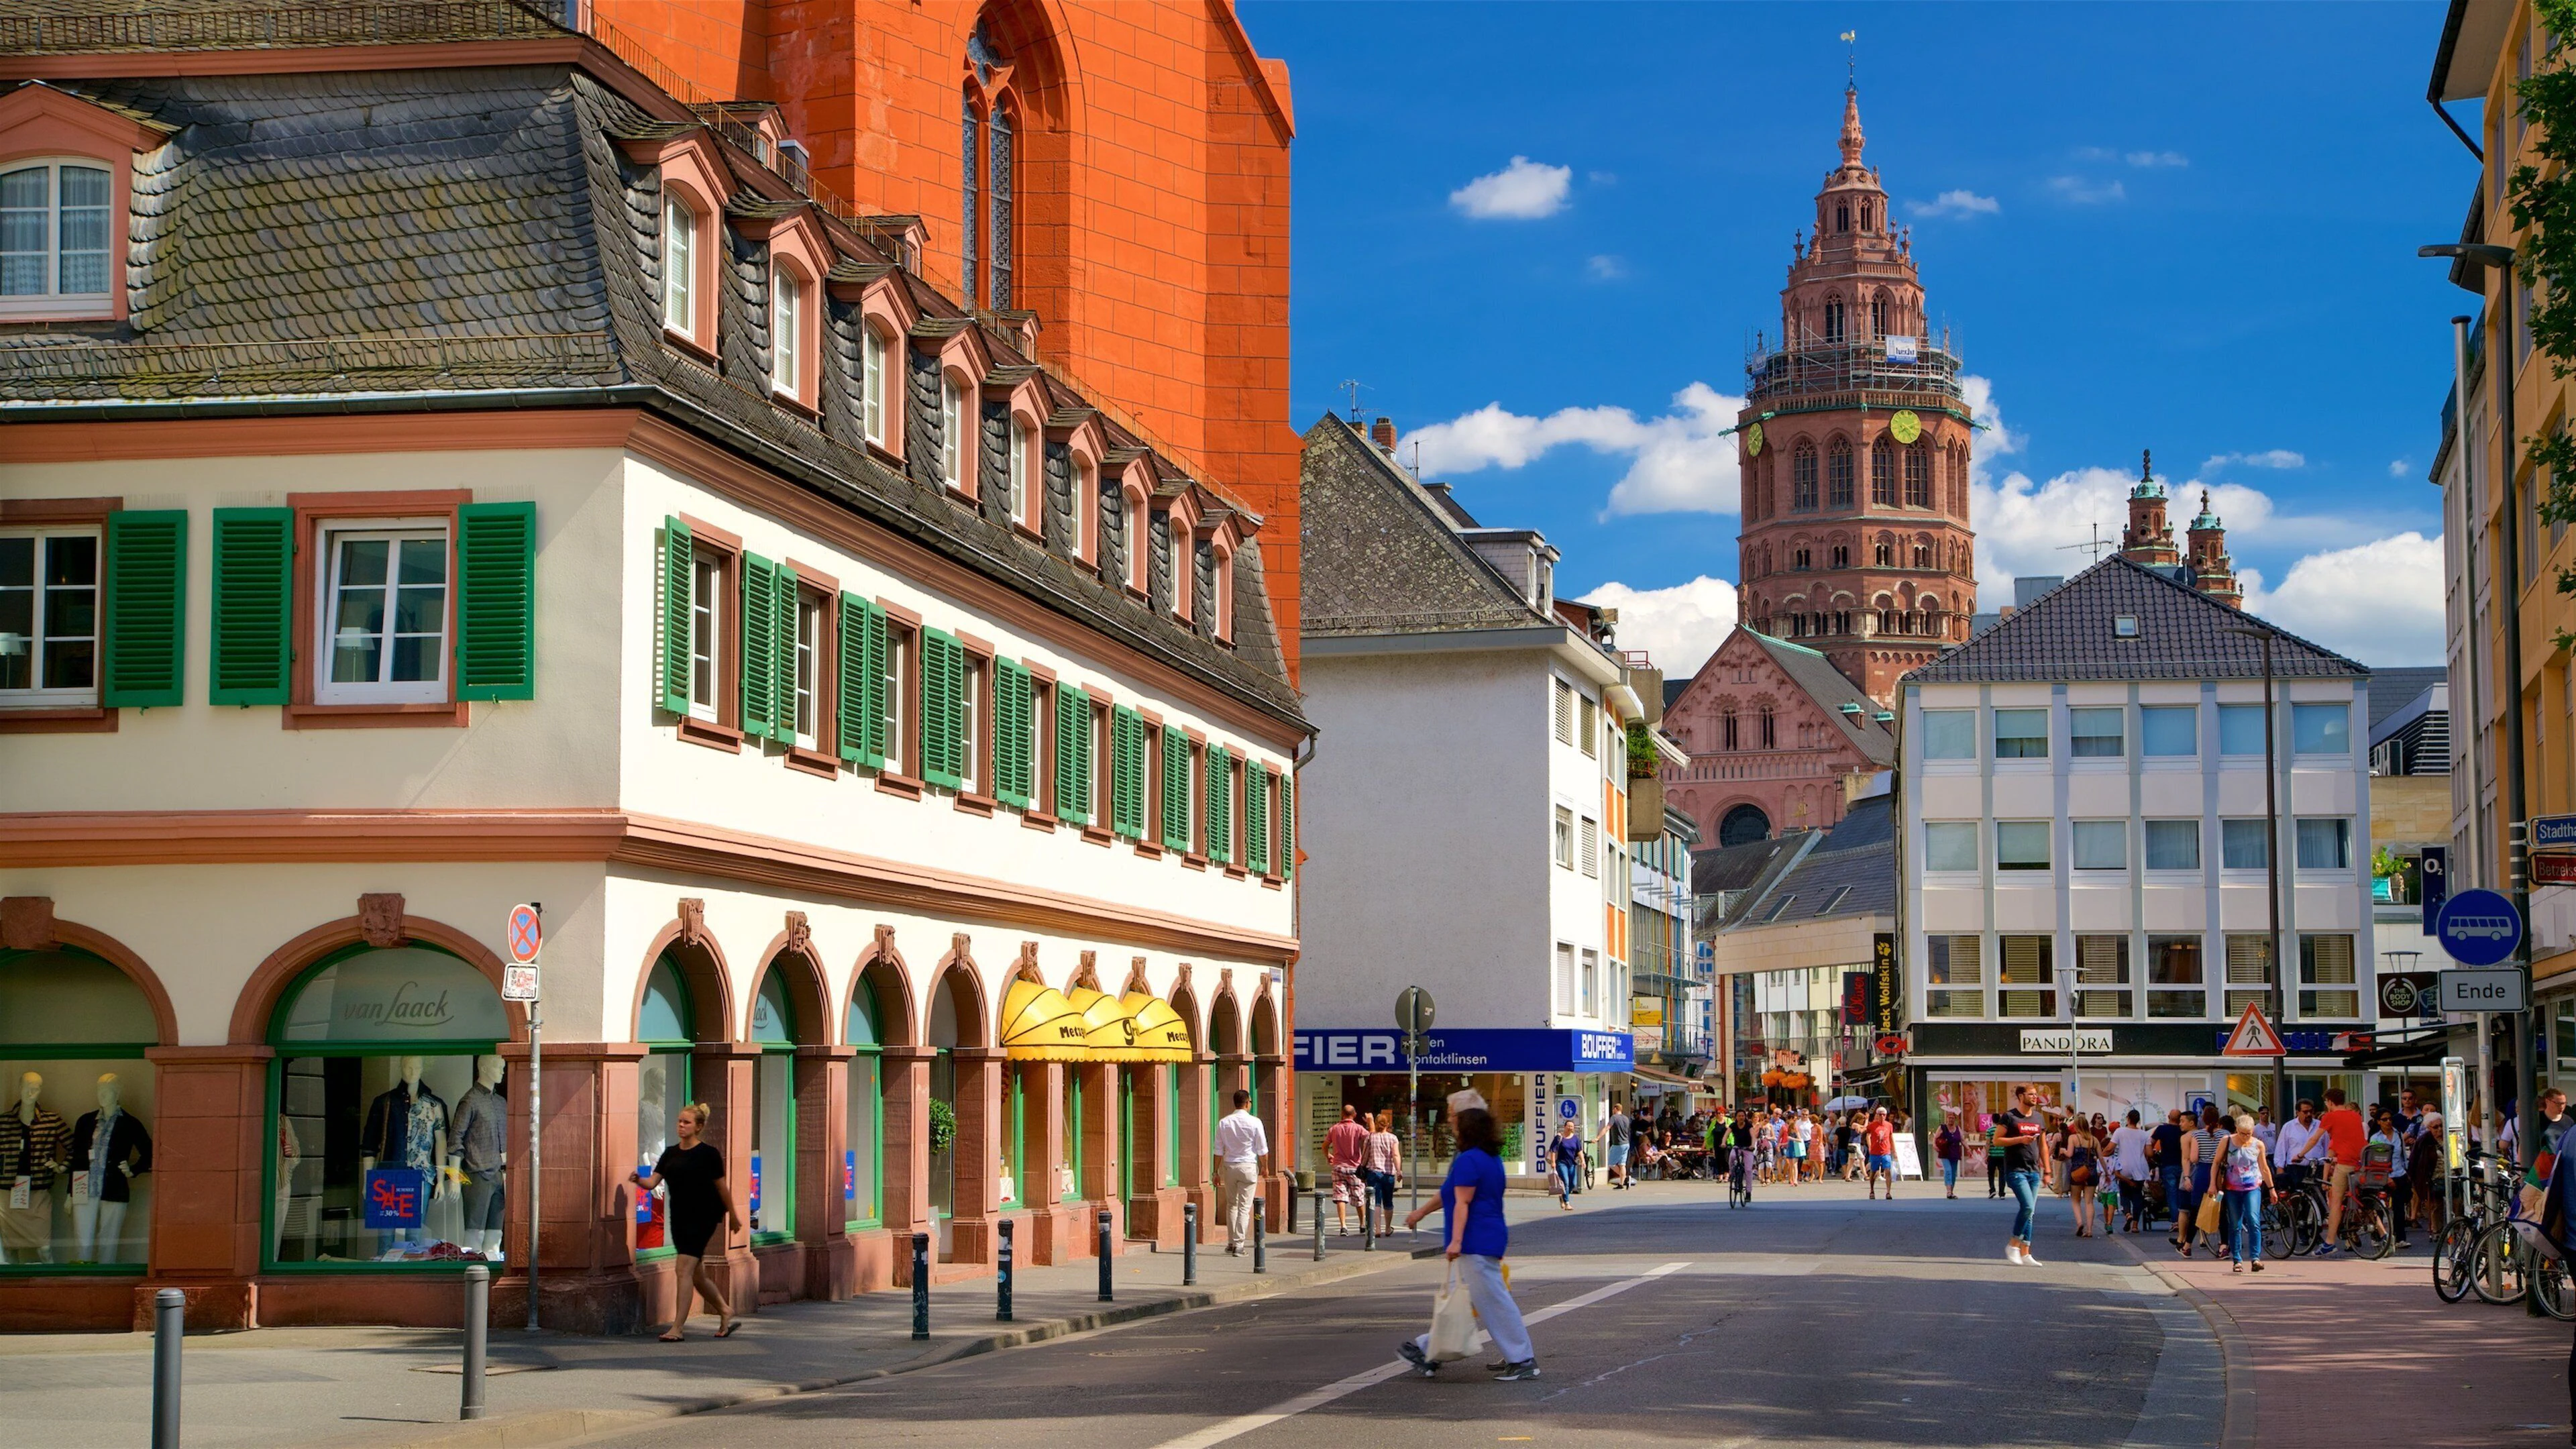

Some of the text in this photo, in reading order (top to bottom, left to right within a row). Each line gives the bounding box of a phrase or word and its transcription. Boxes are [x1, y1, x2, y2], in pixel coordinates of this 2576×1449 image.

[1879, 958, 1891, 1034] Jack Wolfskin
[2457, 983, 2506, 998] Ende
[1582, 1034, 1616, 1059] BOUFFIER
[2023, 1037, 2110, 1049] PANDORA
[1407, 1053, 1487, 1065] kontaktlinsen
[1536, 1074, 1546, 1173] BOUFFIER
